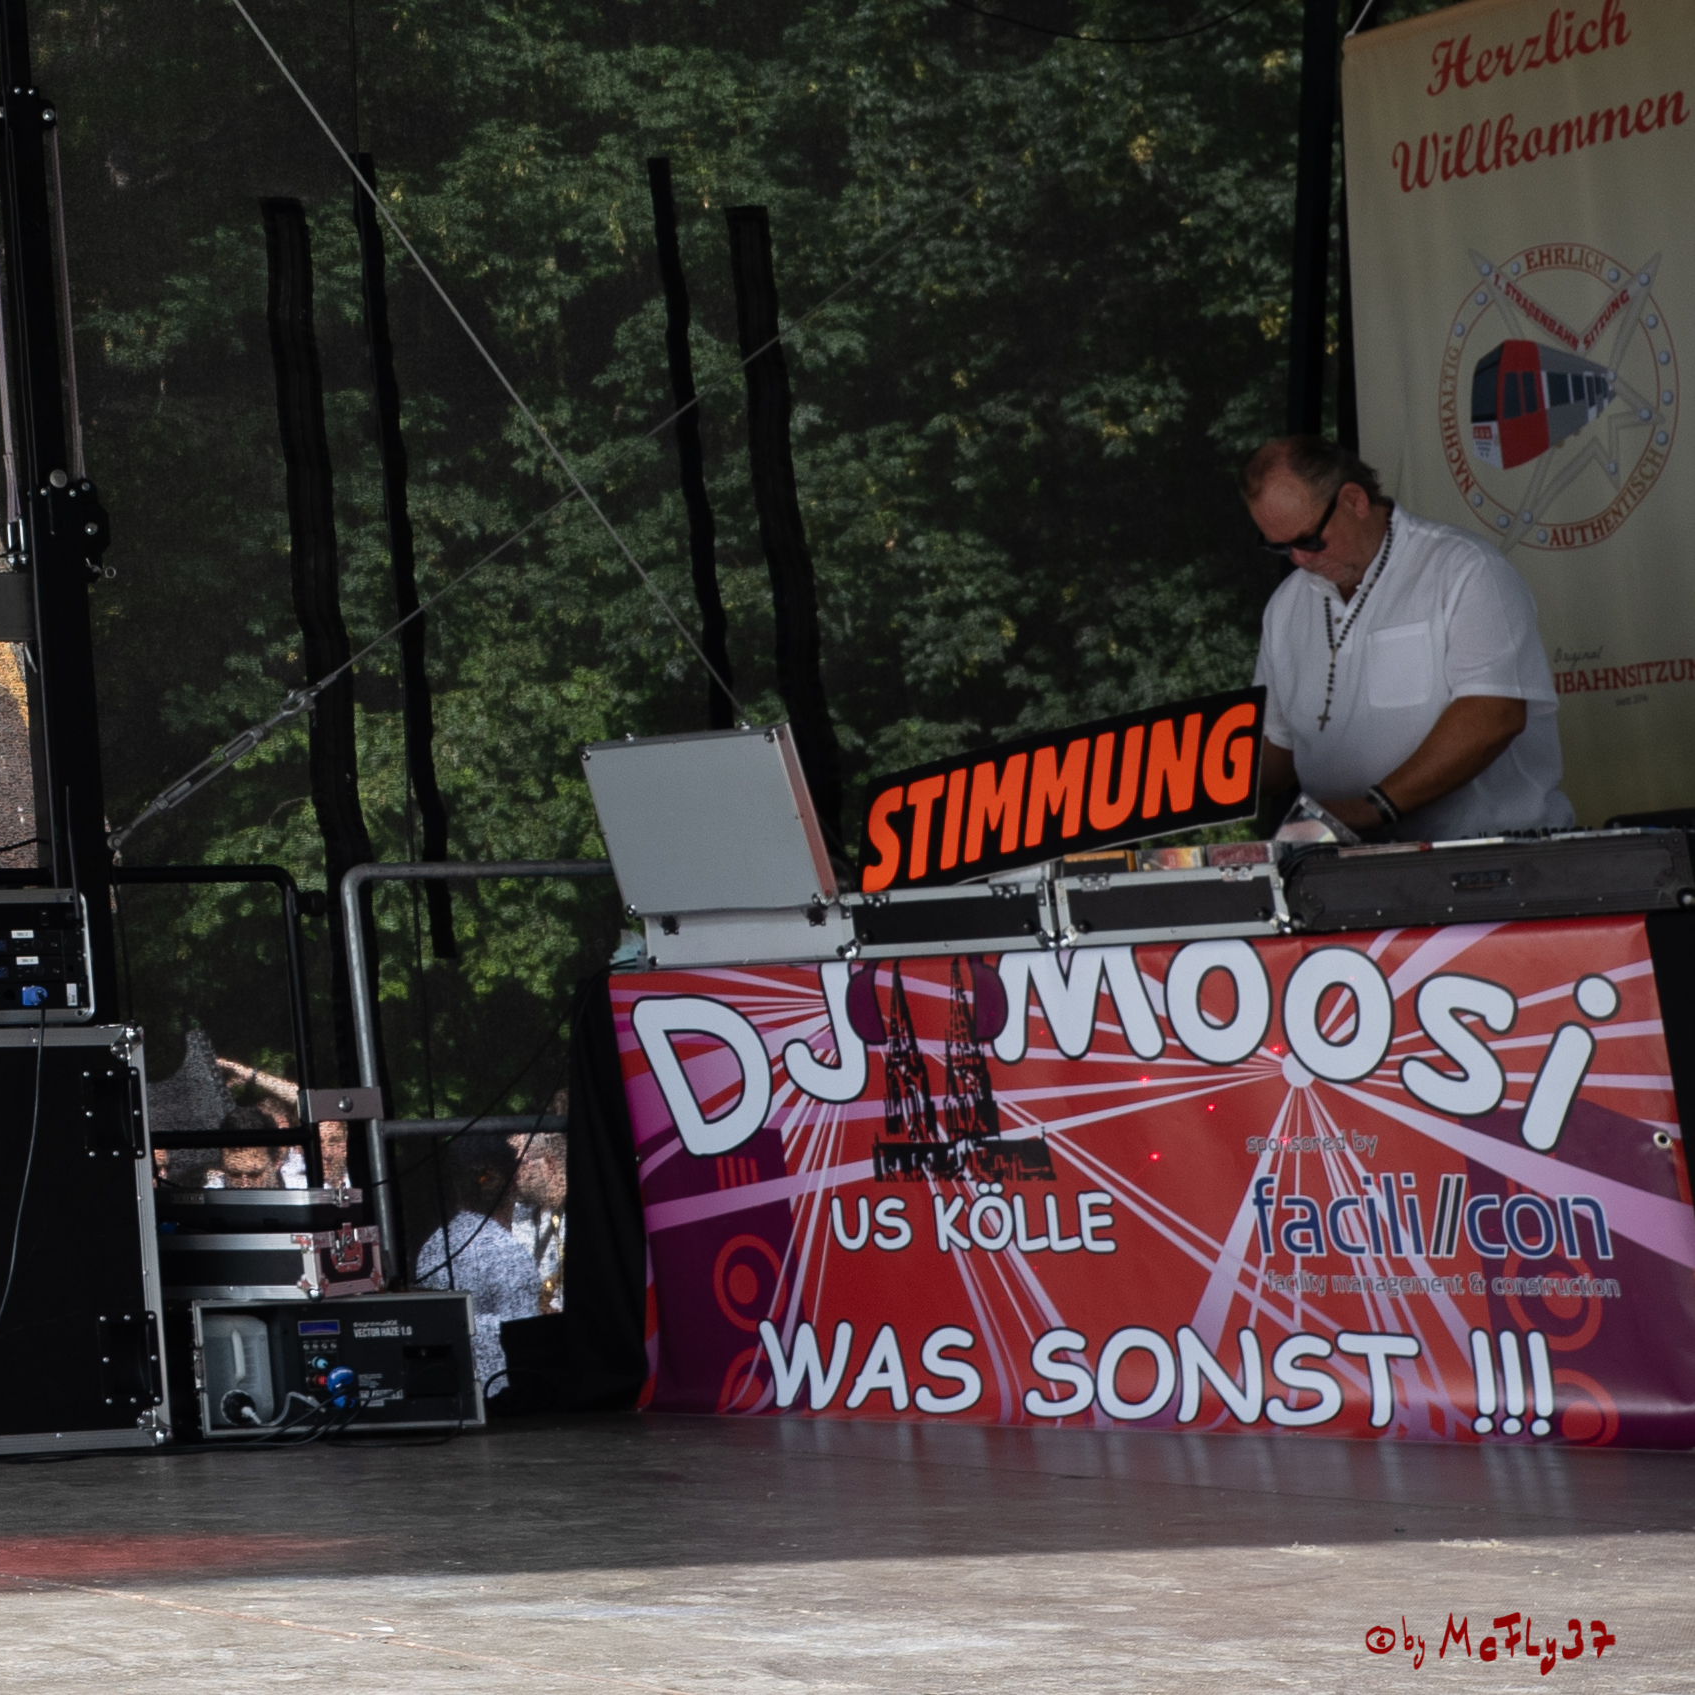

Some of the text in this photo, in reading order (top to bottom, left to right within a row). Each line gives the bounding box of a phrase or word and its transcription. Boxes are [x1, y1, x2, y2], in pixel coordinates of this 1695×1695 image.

[1392, 90, 1690, 193] Willkommen
[1524, 247, 1607, 275] EHRLICH
[1583, 288, 1631, 351] SITZUNG
[1441, 345, 1476, 496] NACHHALTIG
[1549, 447, 1665, 547] AUTHENTISCH
[861, 700, 1260, 894] STIMMUNG
[631, 961, 869, 1159] DJ
[1246, 1129, 1378, 1156] sponsored by
[829, 1183, 1118, 1255] US KÖLLE
[1267, 1270, 1621, 1298] facility management & construction
[353, 1327, 380, 1339] VECTOR
[381, 1326, 400, 1337] HAZE
[758, 1318, 1554, 1438] WAS SONST !!!
